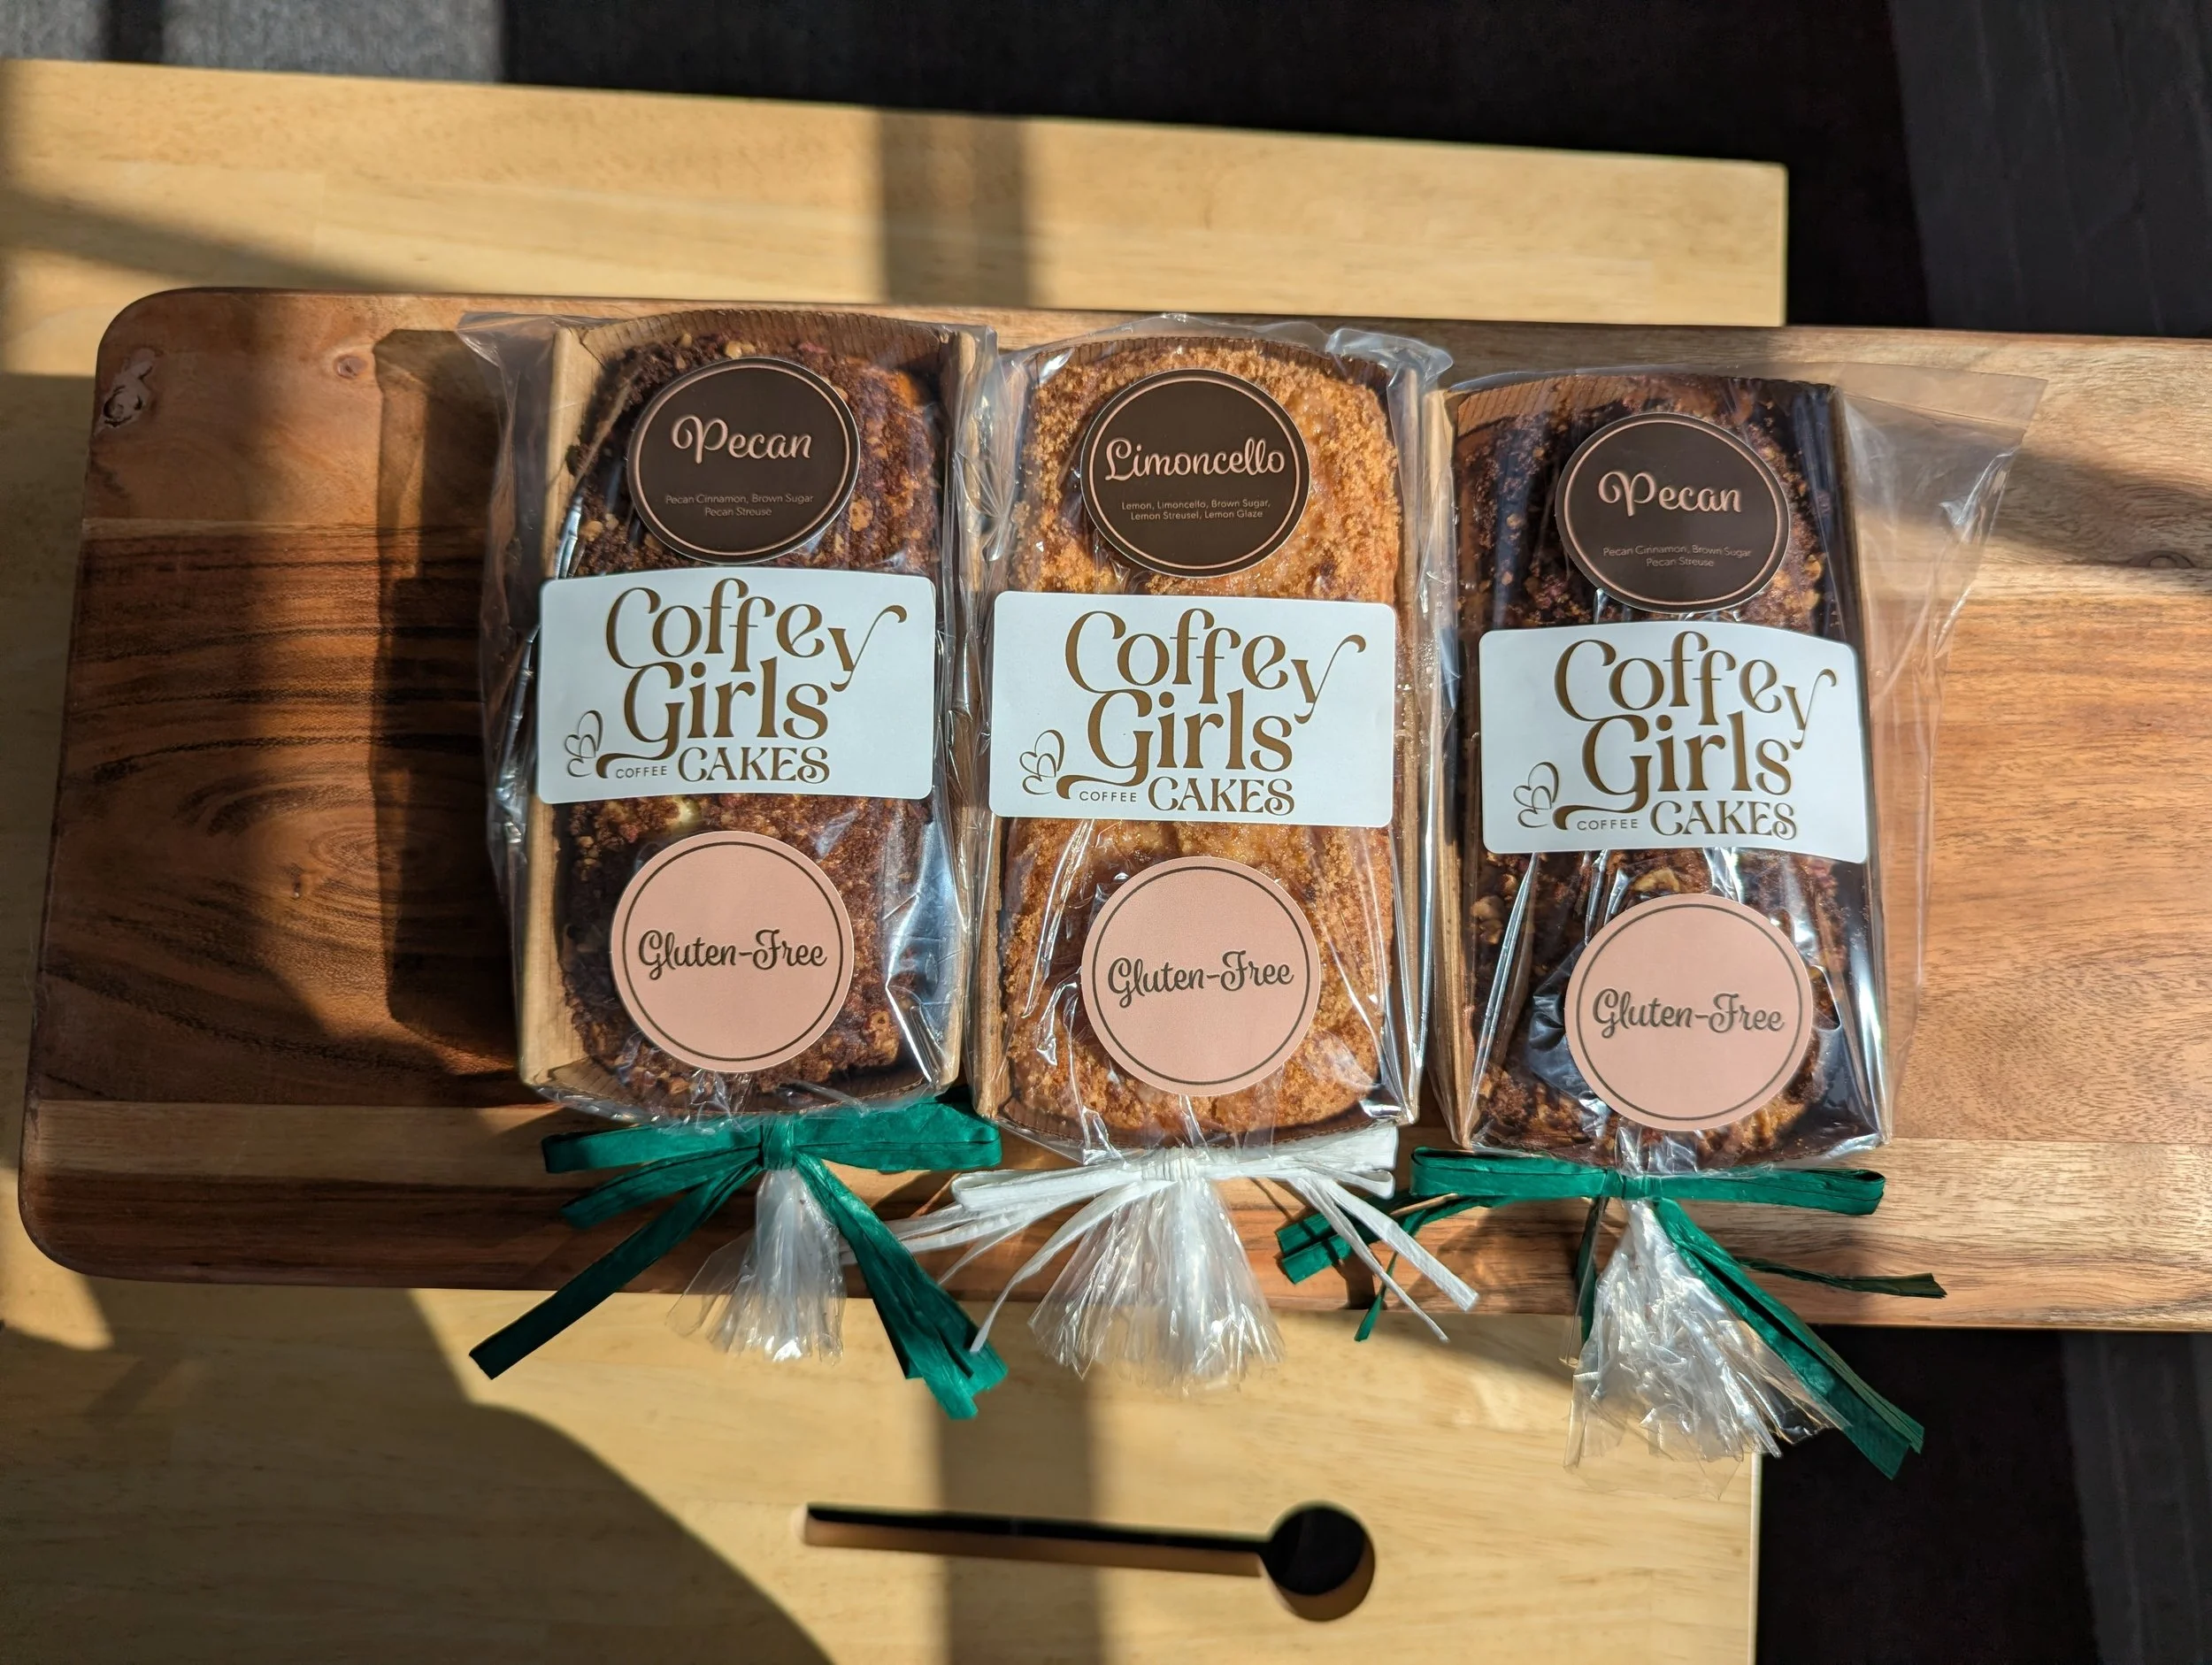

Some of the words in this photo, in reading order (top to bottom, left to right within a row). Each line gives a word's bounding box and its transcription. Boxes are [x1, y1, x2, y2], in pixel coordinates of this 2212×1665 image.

[672, 414, 812, 464] Pecan
[1105, 437, 1285, 481] Limoncello
[665, 495, 694, 504] Pecan
[752, 494, 783, 503] Brown
[785, 493, 814, 504] Sugar
[705, 507, 733, 517] Pecan
[1121, 502, 1155, 510] Lemon,
[1157, 500, 1209, 510] Limoncello,
[1242, 498, 1271, 509] Sugar,
[1131, 511, 1160, 521] Lemon
[1163, 510, 1202, 520] Streusel,
[1236, 510, 1263, 518] Glaze
[1598, 471, 1741, 517] Pecan
[1602, 547, 1633, 556] Pecan
[1692, 544, 1722, 556] Brown
[1724, 547, 1752, 558] Sugar
[1646, 557, 1677, 567] Pecan
[606, 578, 907, 692] Coffey
[1064, 608, 1366, 725] Coffey
[1554, 631, 1838, 750] Coffey
[595, 656, 828, 779] Girls
[616, 765, 668, 779] COFFEE
[678, 746, 830, 785] CAKES
[1056, 688, 1294, 800] Girls
[1552, 710, 1792, 831] Girls
[1079, 791, 1137, 802] COFFEE
[1148, 776, 1295, 816] CAKES
[1577, 818, 1639, 831] COFFEE
[1650, 800, 1797, 840] CAKES
[638, 929, 827, 980] Gluten-Free
[1108, 950, 1294, 1009] Gluten-Free
[1593, 987, 1786, 1039] Gluten-Free
